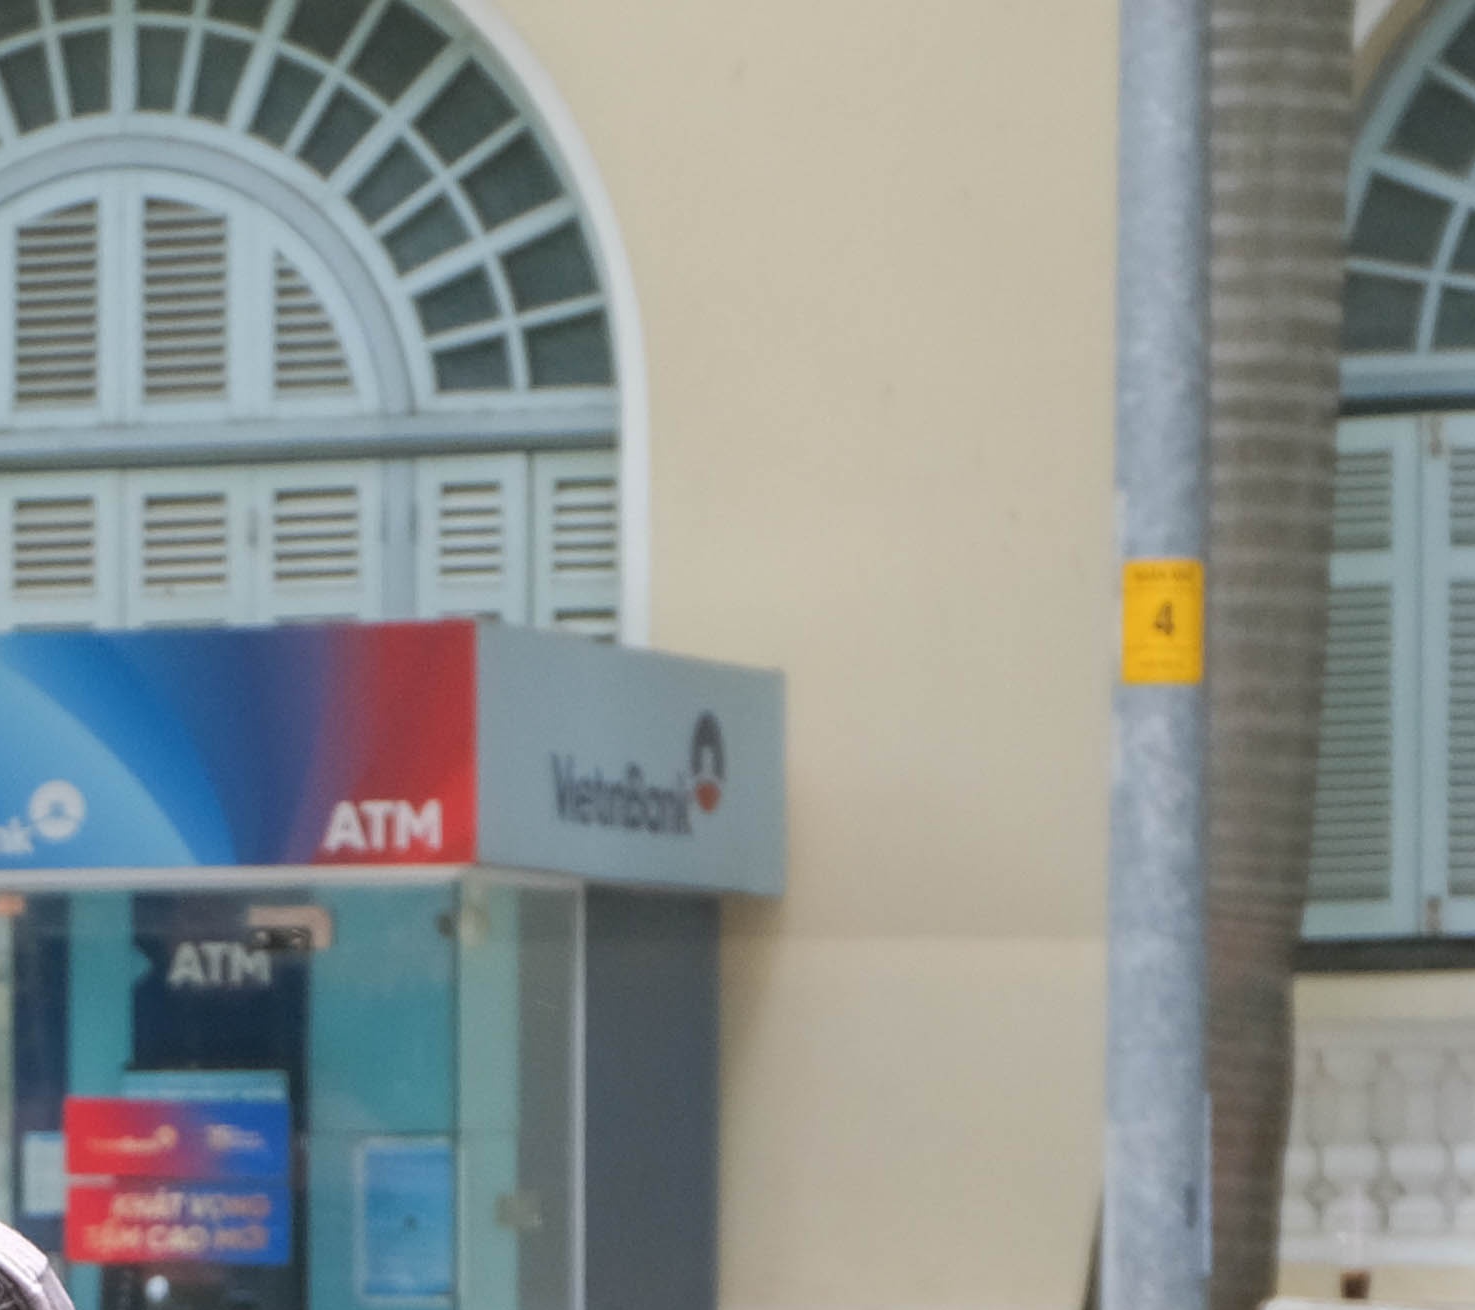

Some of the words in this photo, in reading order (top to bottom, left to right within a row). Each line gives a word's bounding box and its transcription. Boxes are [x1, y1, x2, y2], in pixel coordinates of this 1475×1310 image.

[1154, 601, 1175, 636] 4
[323, 799, 443, 852] ATM
[168, 941, 272, 988] ATM
